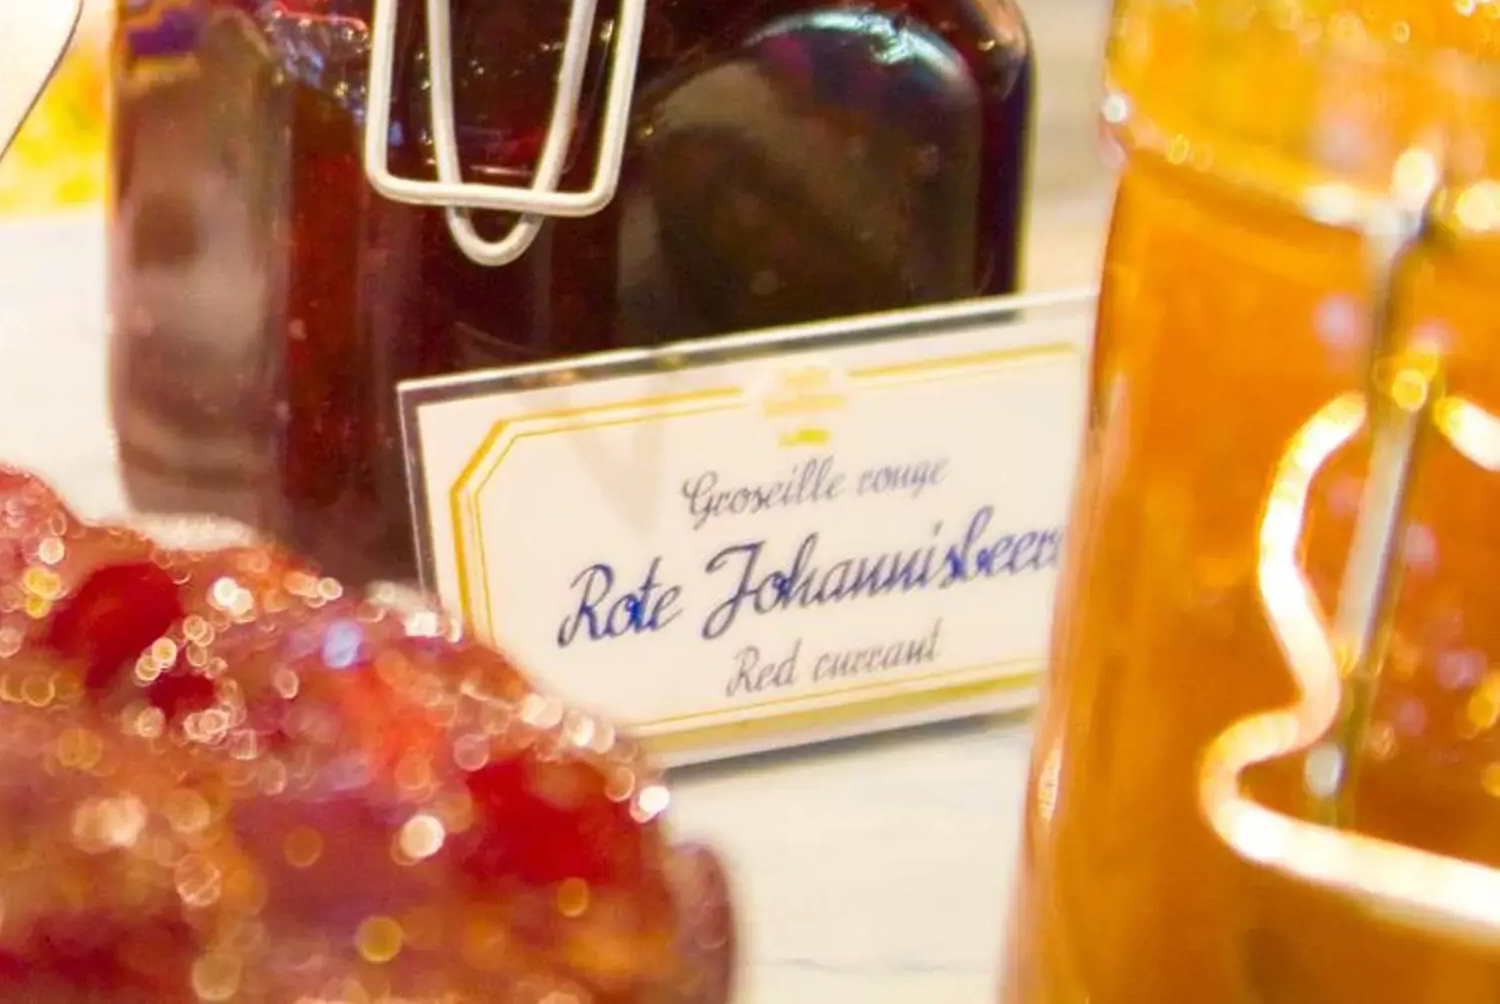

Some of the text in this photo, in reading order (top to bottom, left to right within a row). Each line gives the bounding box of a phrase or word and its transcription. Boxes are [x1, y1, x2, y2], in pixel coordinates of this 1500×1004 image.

[682, 455, 951, 531] Groseille rouge
[557, 557, 684, 648] Rote
[726, 618, 943, 697] Red currant
